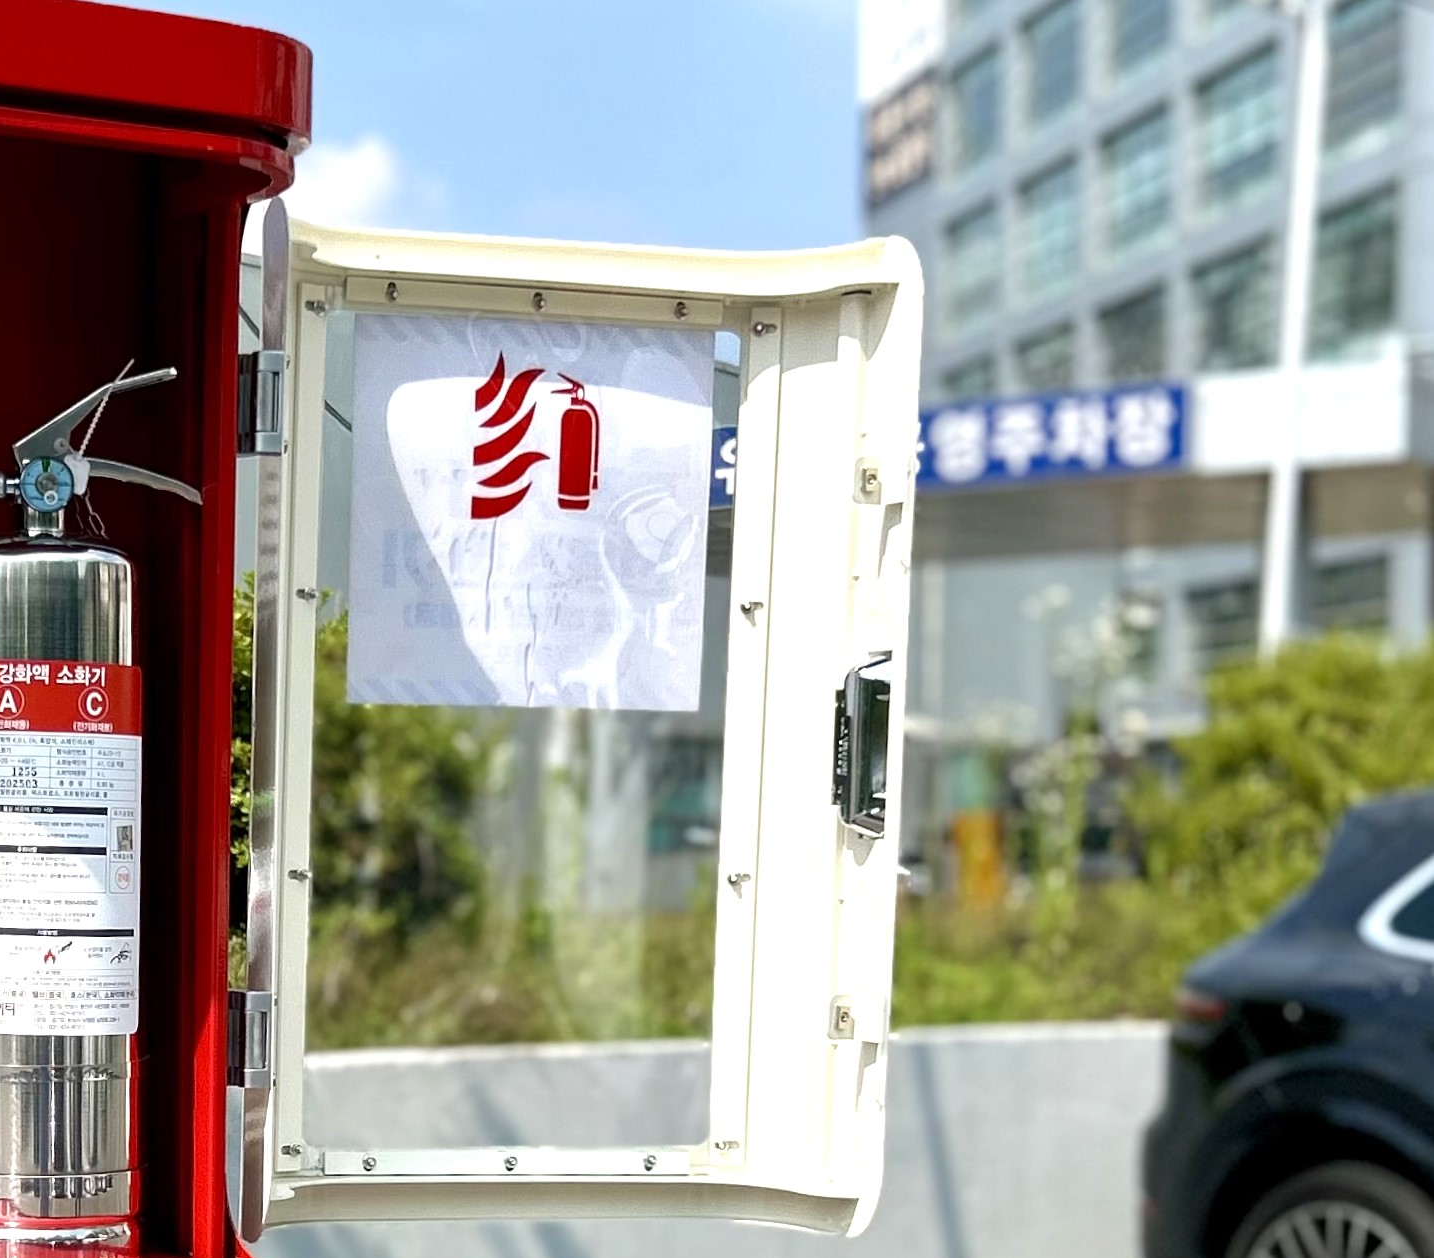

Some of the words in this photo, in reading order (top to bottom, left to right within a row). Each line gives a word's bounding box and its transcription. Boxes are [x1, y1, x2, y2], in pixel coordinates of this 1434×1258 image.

[916, 390, 1175, 483] 영주차장
[56, 665, 106, 687] 소화기
[86, 692, 103, 716] C
[0, 778, 38, 788] 202503
[12, 767, 37, 777] 1255
